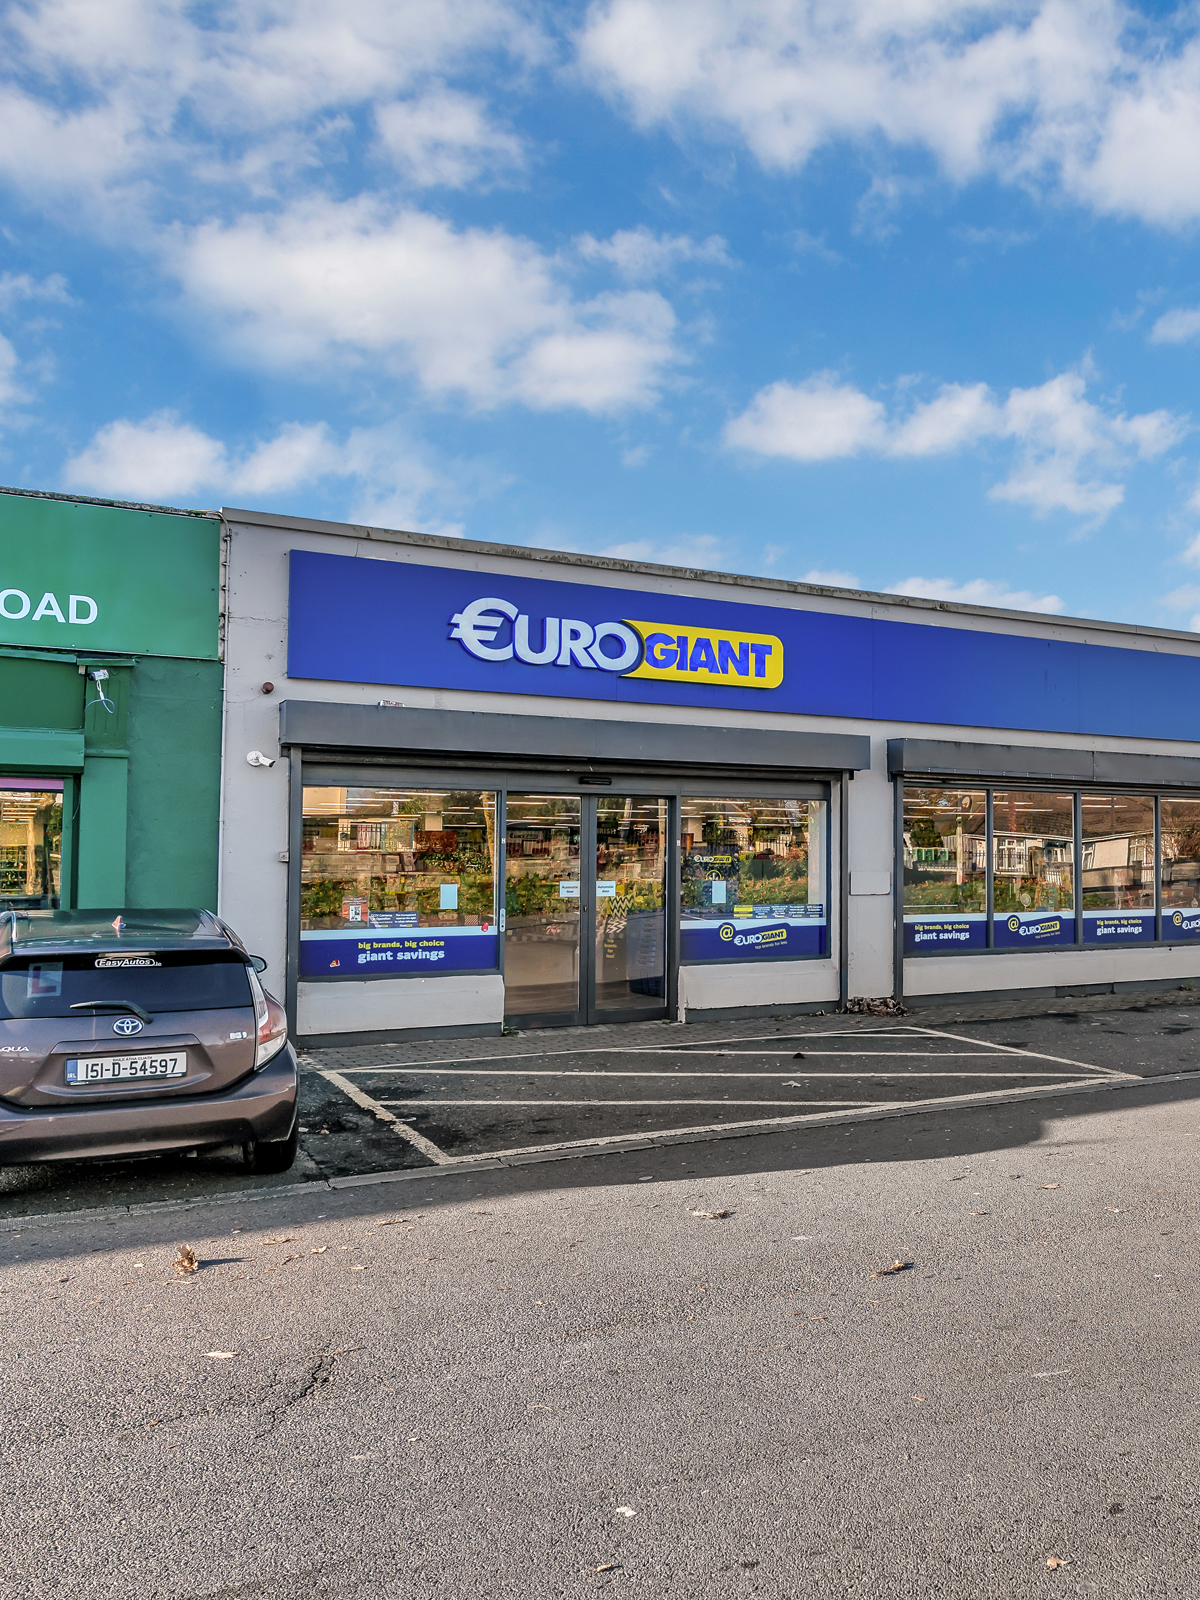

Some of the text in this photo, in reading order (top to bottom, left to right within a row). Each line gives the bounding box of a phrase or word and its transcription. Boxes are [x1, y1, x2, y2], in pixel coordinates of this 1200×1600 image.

[1097, 925, 1142, 935] giant savings
[915, 931, 970, 942] giant savings
[358, 942, 371, 950] big
[358, 949, 445, 963] giant savings
[32, 966, 56, 994] L
[86, 1058, 178, 1079] 151-D-54597
